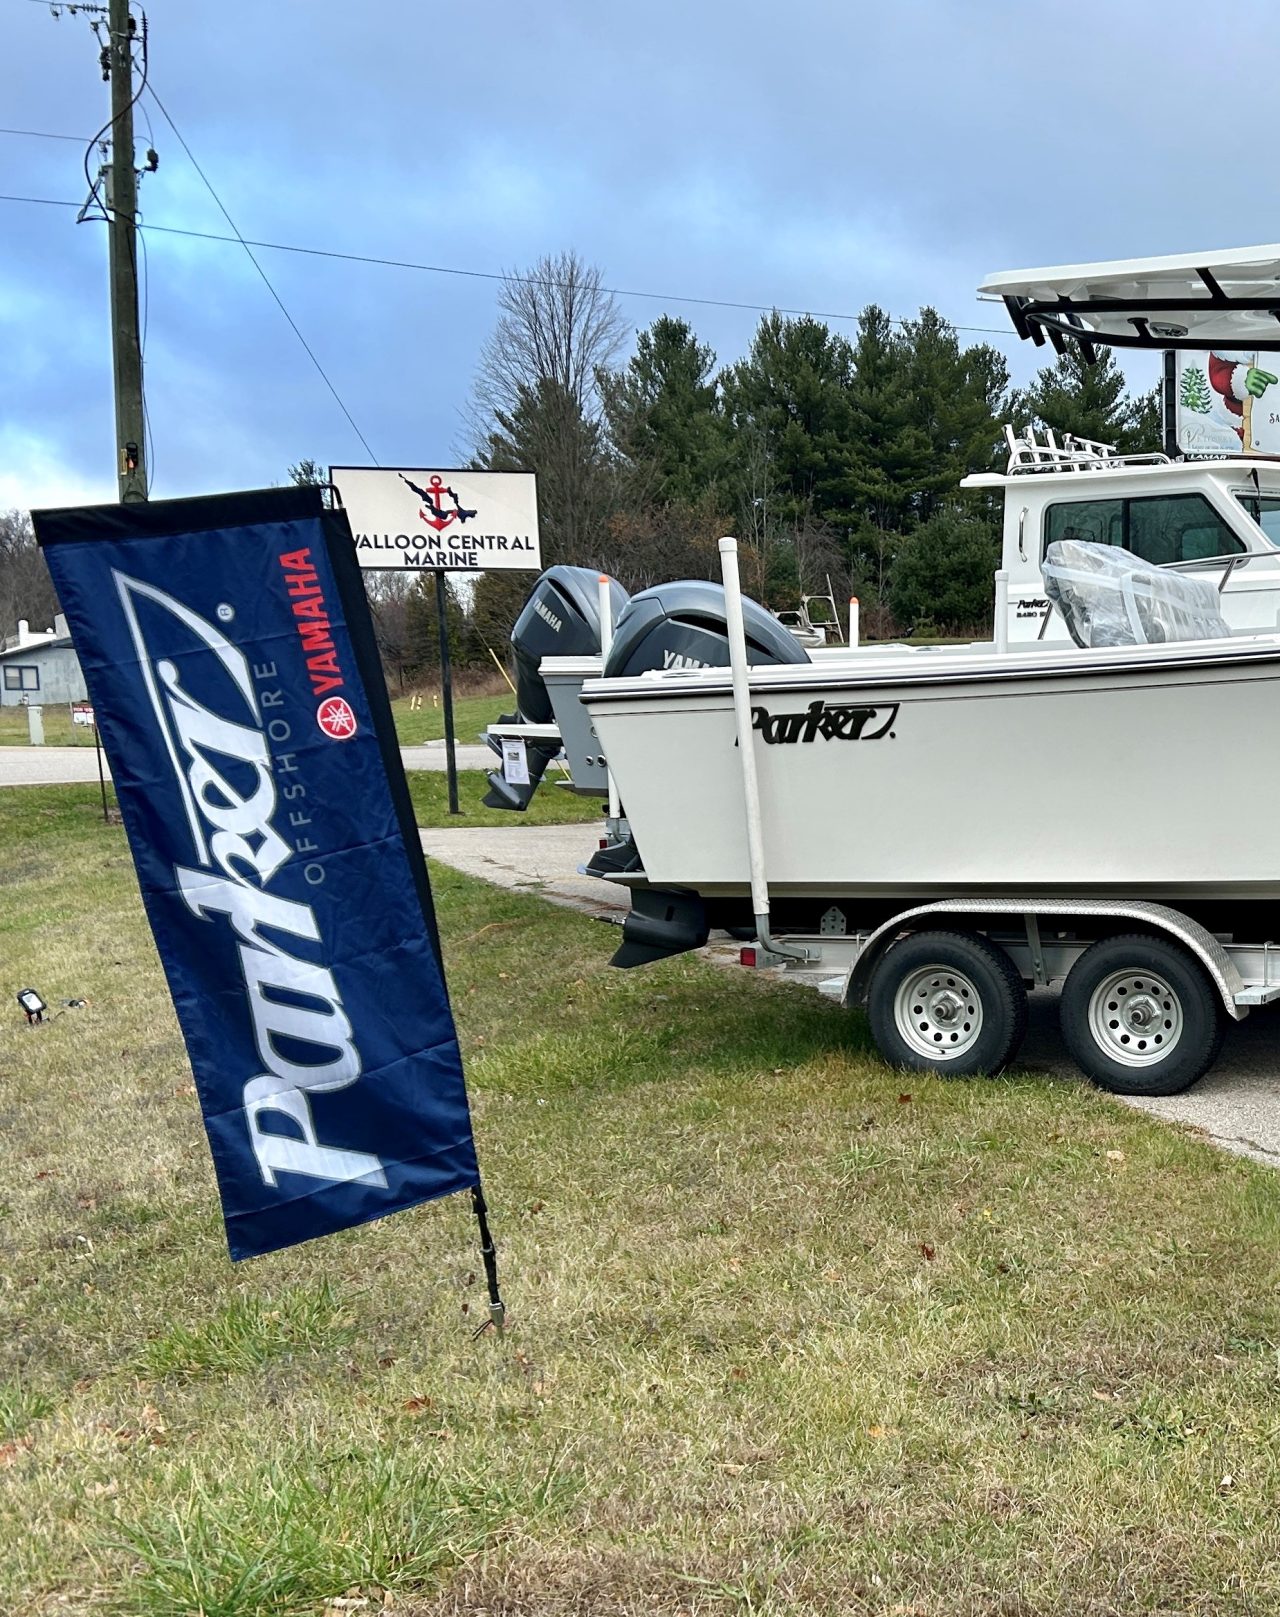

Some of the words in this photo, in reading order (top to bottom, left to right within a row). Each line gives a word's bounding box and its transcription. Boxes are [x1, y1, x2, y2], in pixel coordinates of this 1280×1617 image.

[404, 550, 478, 567] MARINE
[447, 534, 535, 551] CENTRAL
[279, 546, 346, 698] YAMAHA
[533, 596, 563, 633] YAMAHA
[253, 658, 327, 888] OFFSHORE
[111, 567, 389, 1190] Parker
